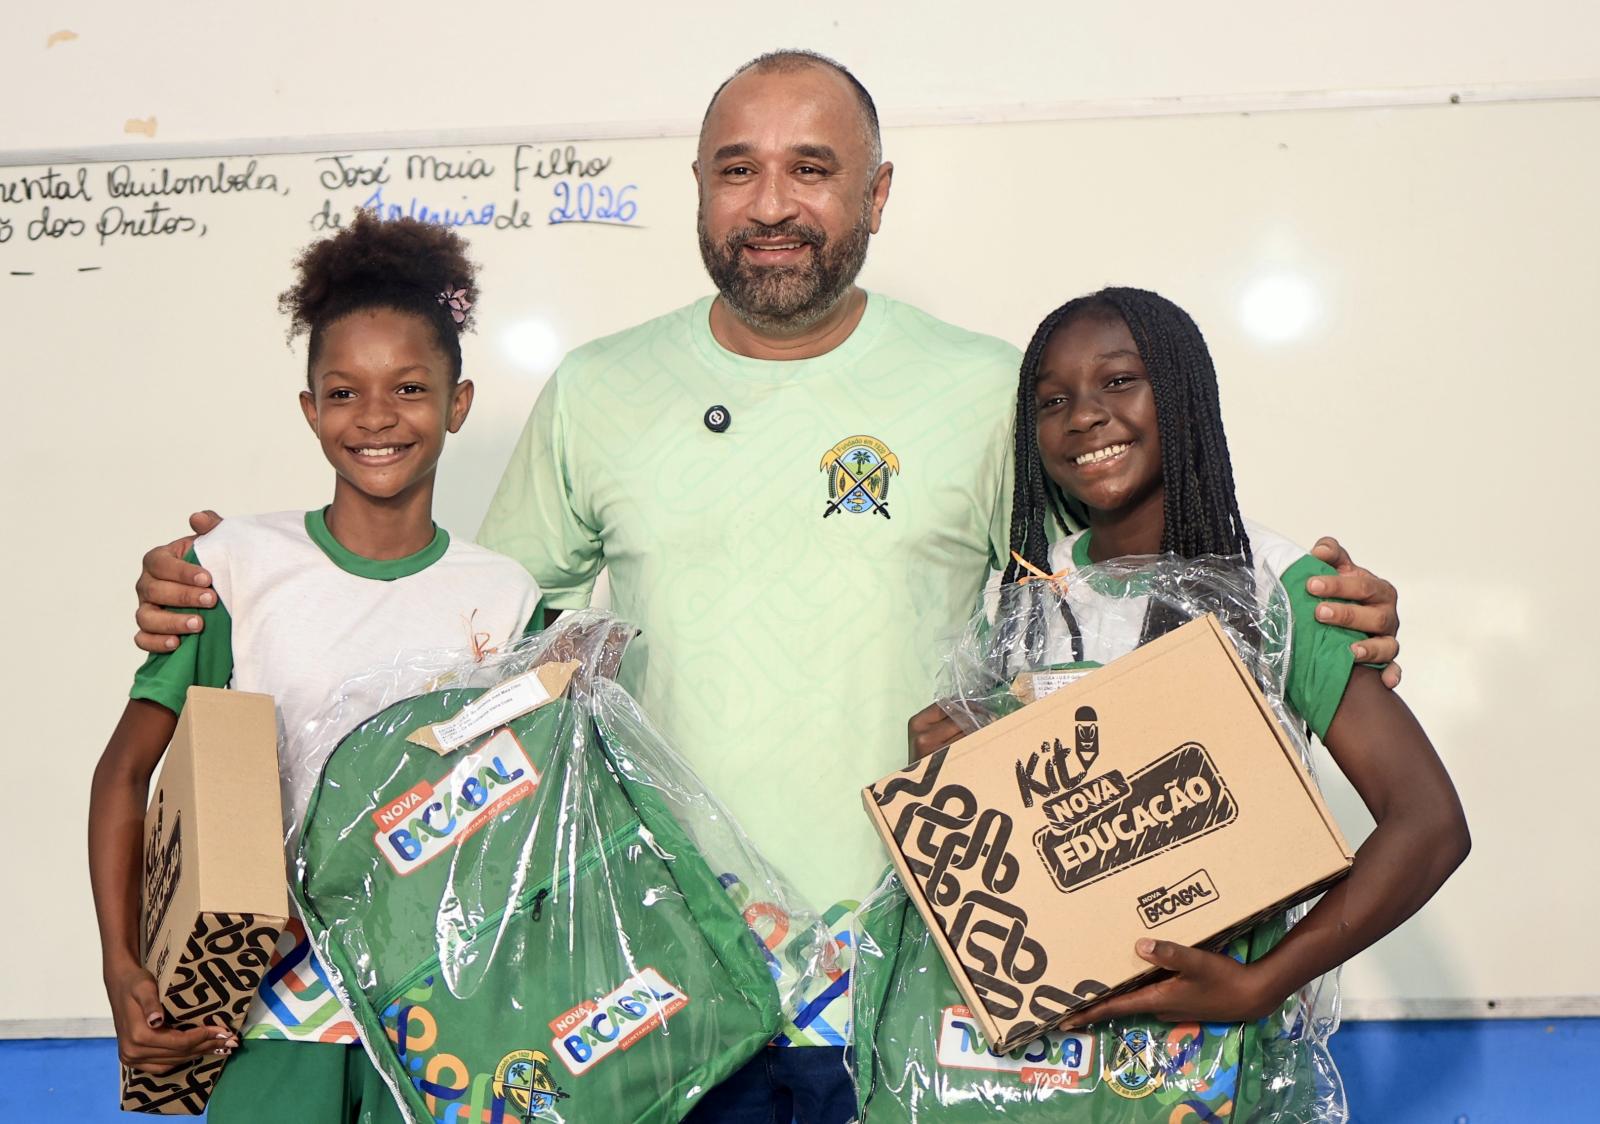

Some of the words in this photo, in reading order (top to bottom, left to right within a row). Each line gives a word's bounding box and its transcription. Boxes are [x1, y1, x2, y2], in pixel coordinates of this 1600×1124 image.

[407, 150, 495, 181] Maia
[514, 145, 612, 192] Filho
[28, 206, 85, 241] dos
[310, 199, 344, 231] de
[495, 199, 533, 229] de
[548, 181, 639, 224] 2026
[1016, 738, 1086, 808] Kit
[381, 792, 423, 825] NOVA
[389, 756, 524, 861] BACABAL
[1052, 778, 1121, 822] NOVA
[1054, 776, 1212, 871] EDUCAÇÃO
[1141, 890, 1163, 905] NOVA
[1144, 882, 1212, 923] BACABAL
[556, 1006, 588, 1032] NOVA
[1033, 1071, 1072, 1085] NOVA
